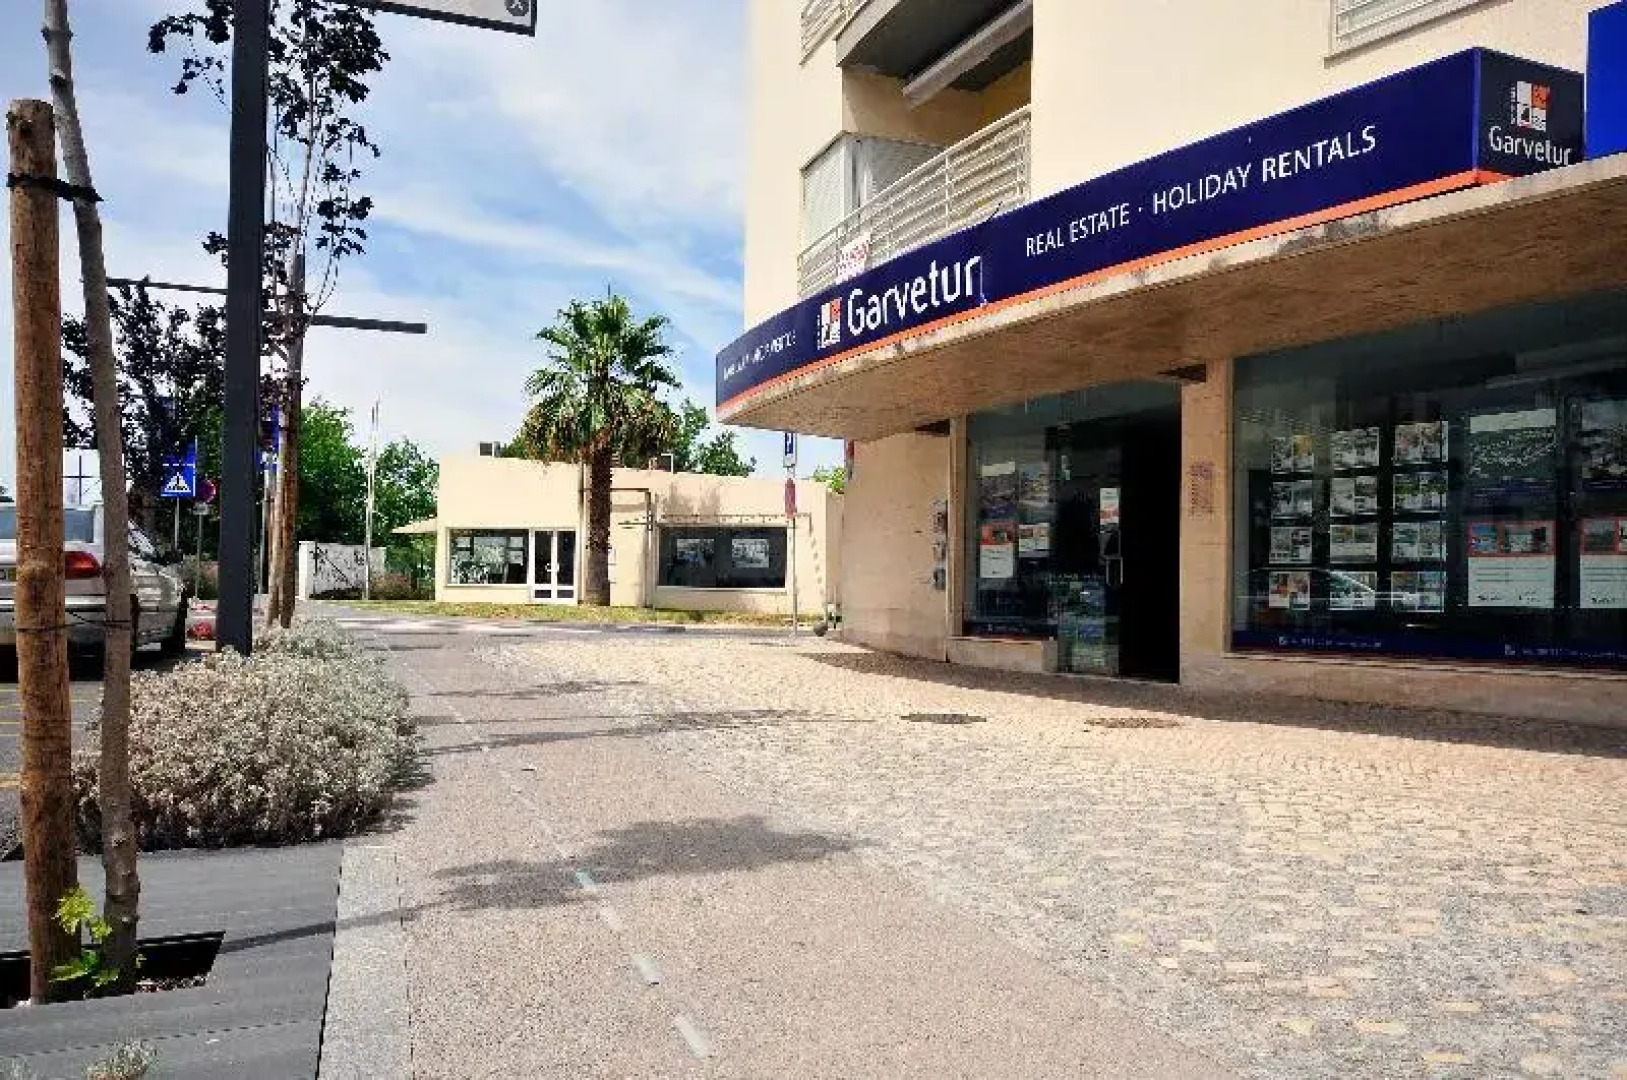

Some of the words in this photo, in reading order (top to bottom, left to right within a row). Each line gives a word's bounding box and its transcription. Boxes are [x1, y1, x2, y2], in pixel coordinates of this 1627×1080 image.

[1489, 125, 1572, 166] Garvetur
[1026, 227, 1064, 257] REAL
[1069, 203, 1130, 243] ESTATE
[1153, 162, 1252, 214] HOLIDAY
[1262, 125, 1376, 183] RENTALS
[847, 255, 982, 337] Garvetur
